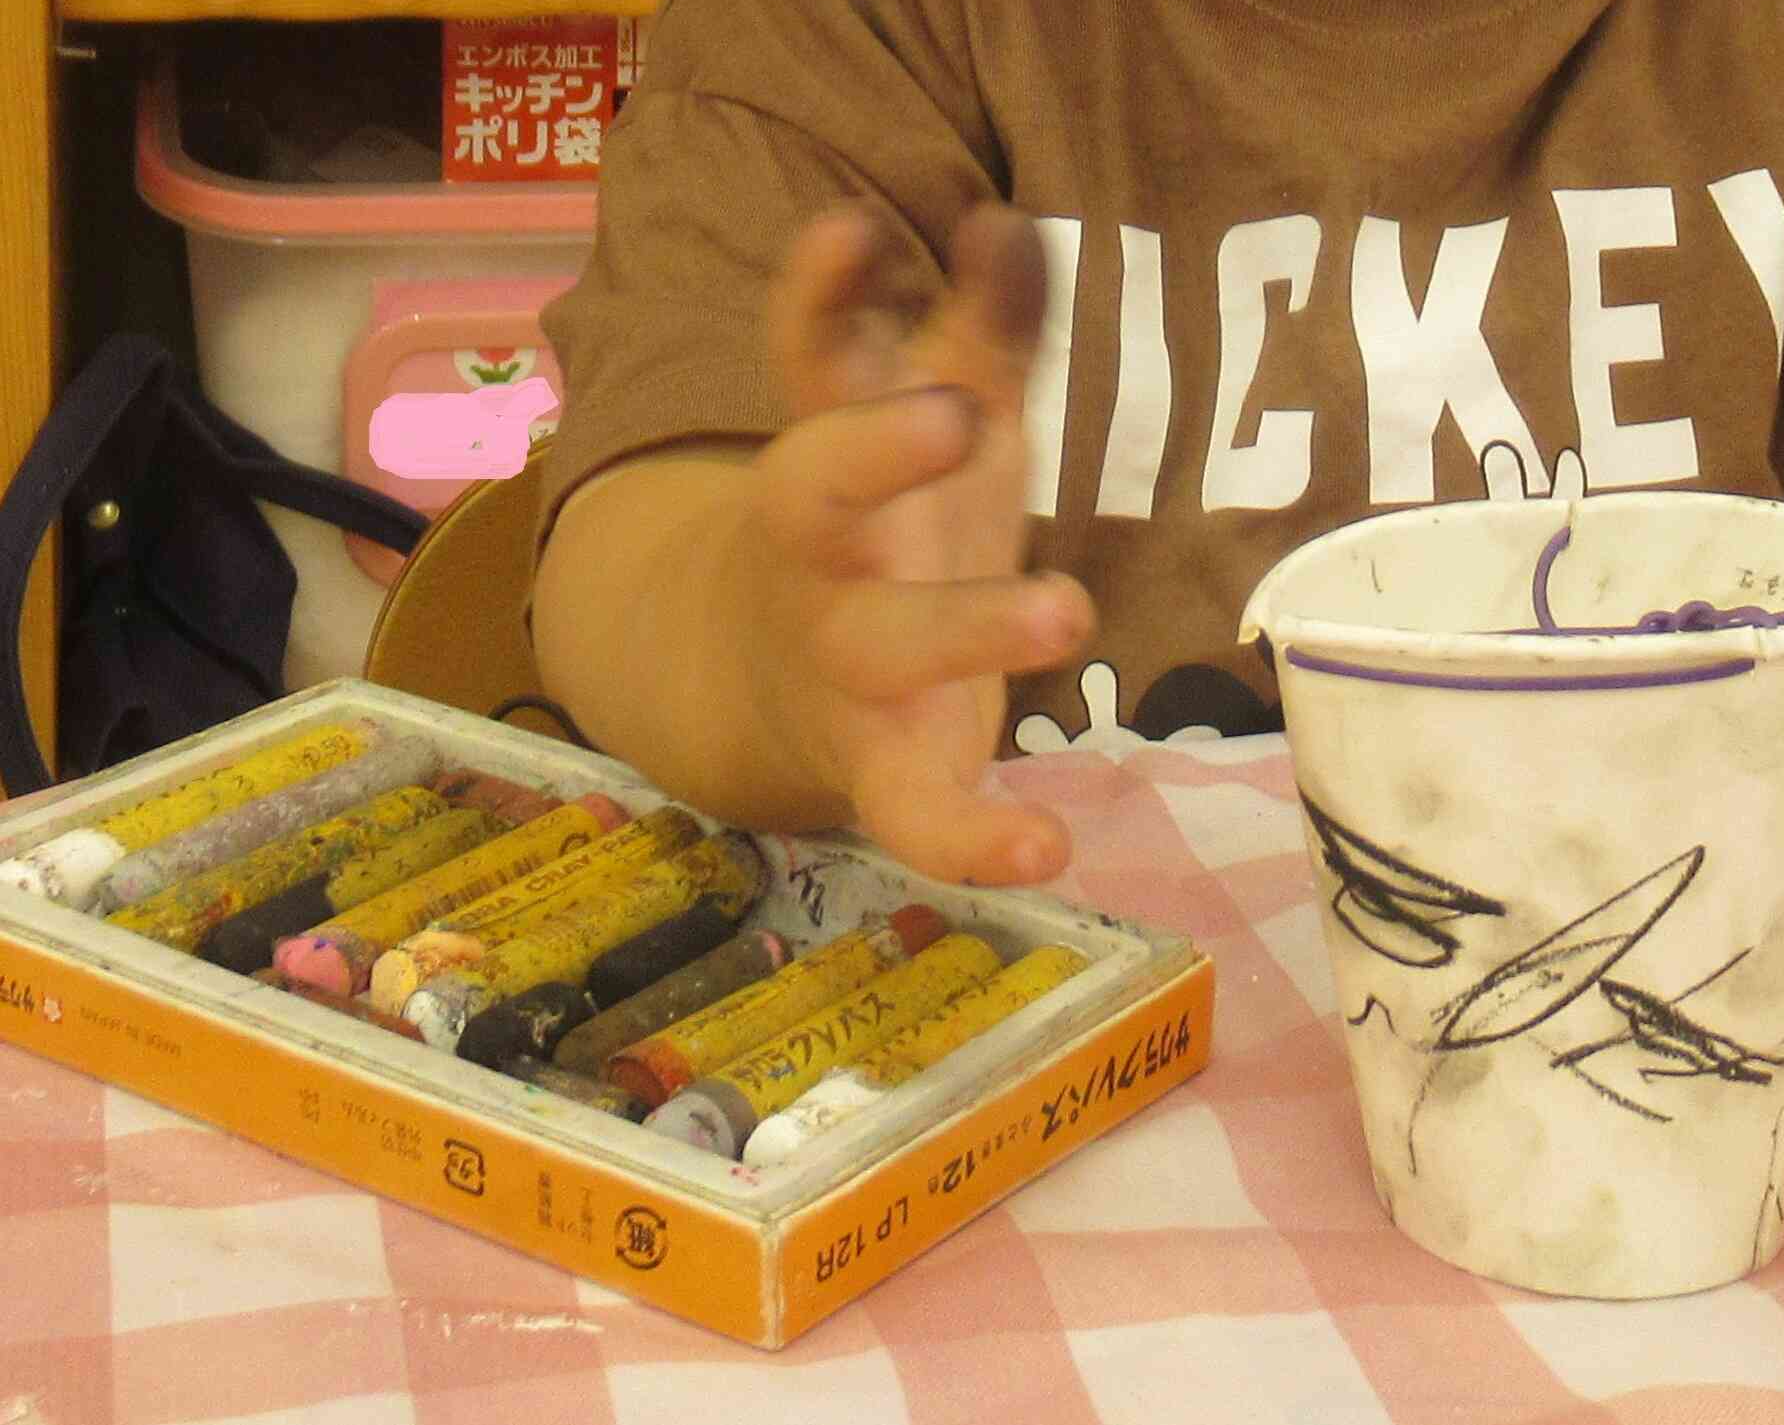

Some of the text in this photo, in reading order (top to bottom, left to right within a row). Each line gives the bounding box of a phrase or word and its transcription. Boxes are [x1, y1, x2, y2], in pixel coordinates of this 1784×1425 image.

[454, 72, 603, 113] キッチン
[453, 115, 602, 165] ポリ袋
[1040, 1010, 1191, 1142] サクラクレパス
[874, 1195, 909, 1243] LP
[815, 1222, 866, 1283] 12R
